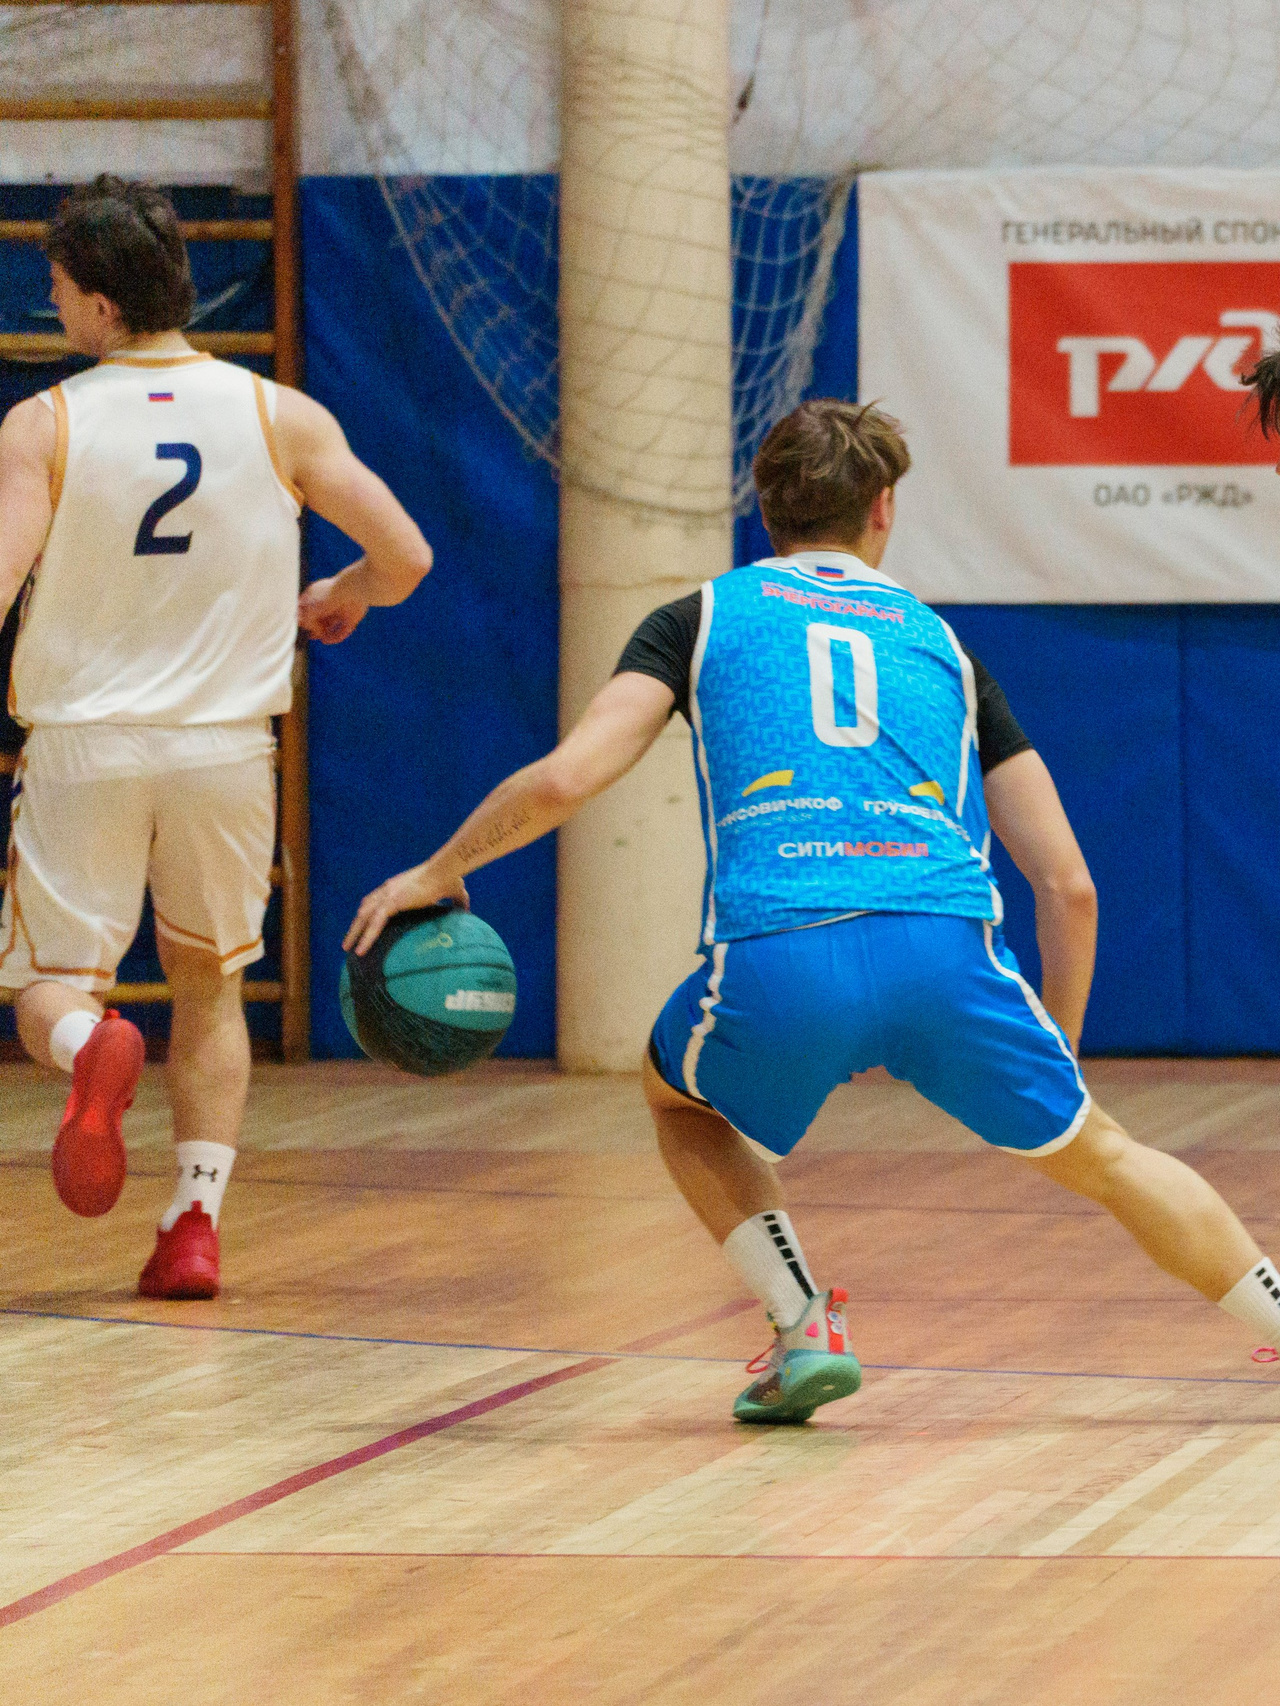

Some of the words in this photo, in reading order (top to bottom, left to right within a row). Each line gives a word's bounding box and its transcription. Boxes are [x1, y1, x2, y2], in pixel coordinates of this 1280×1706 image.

[1002, 219, 1203, 244] ГЕНЕРАЛЬНЫЙ
[133, 441, 203, 557] 2
[1093, 483, 1150, 507] ОАО
[806, 622, 880, 748] 0
